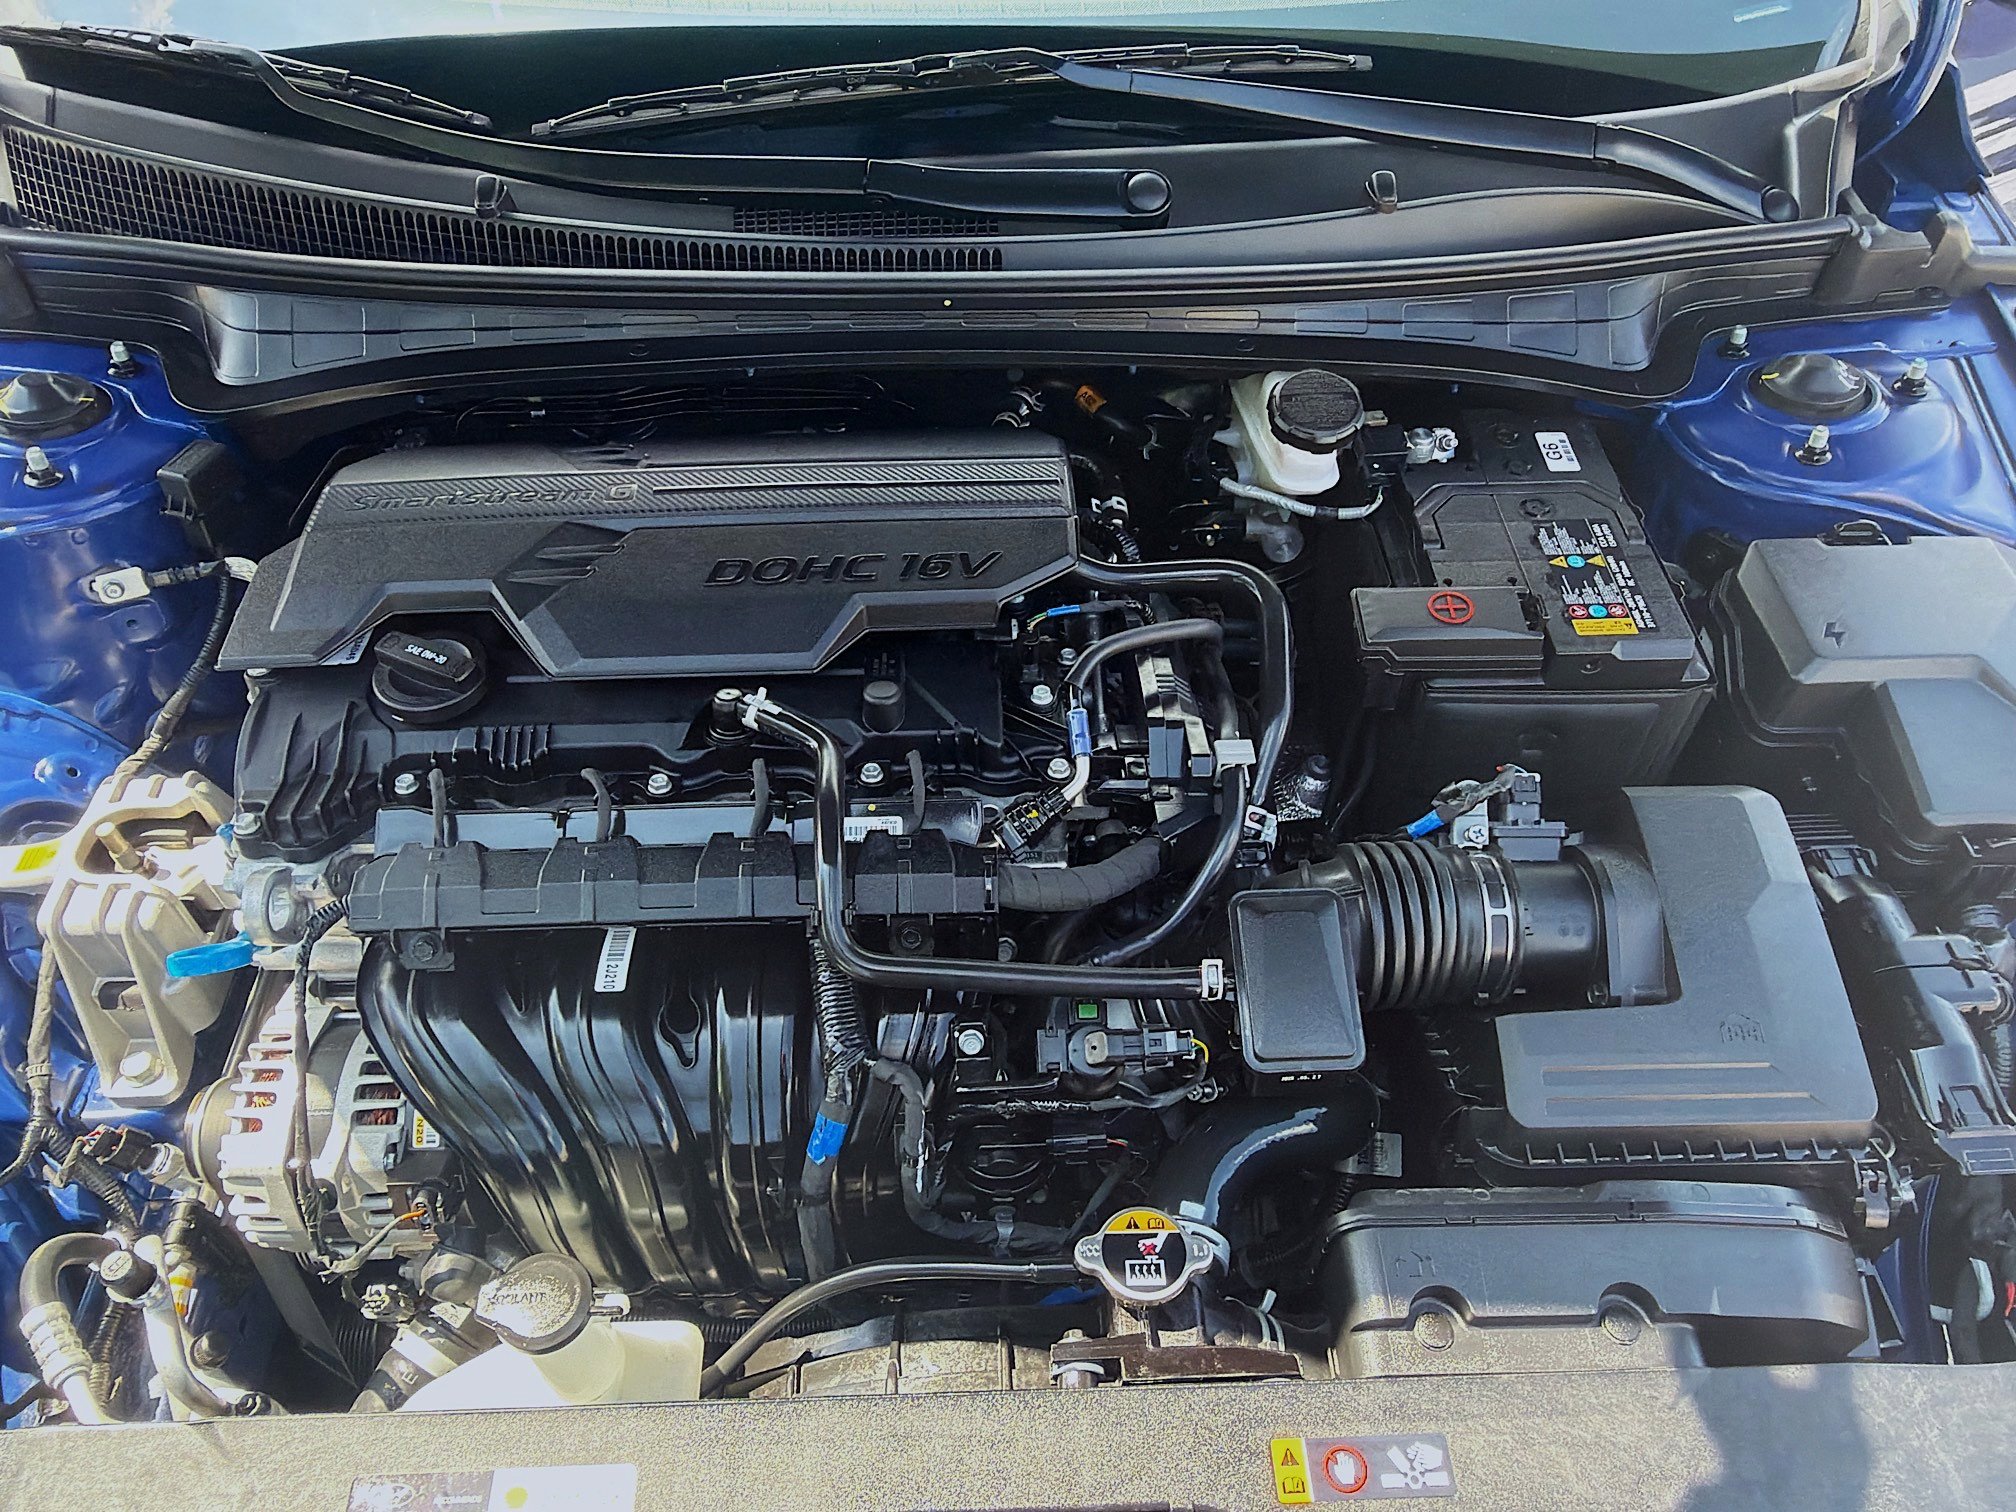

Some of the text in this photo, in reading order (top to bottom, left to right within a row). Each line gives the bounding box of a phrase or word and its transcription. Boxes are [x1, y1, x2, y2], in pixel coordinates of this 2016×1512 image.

[1542, 442, 1563, 461] G6
[345, 489, 597, 511] Smartstream
[703, 550, 1004, 587] DOHC 16V
[404, 644, 448, 666] SAE 0W-20
[603, 964, 619, 990] 2J210
